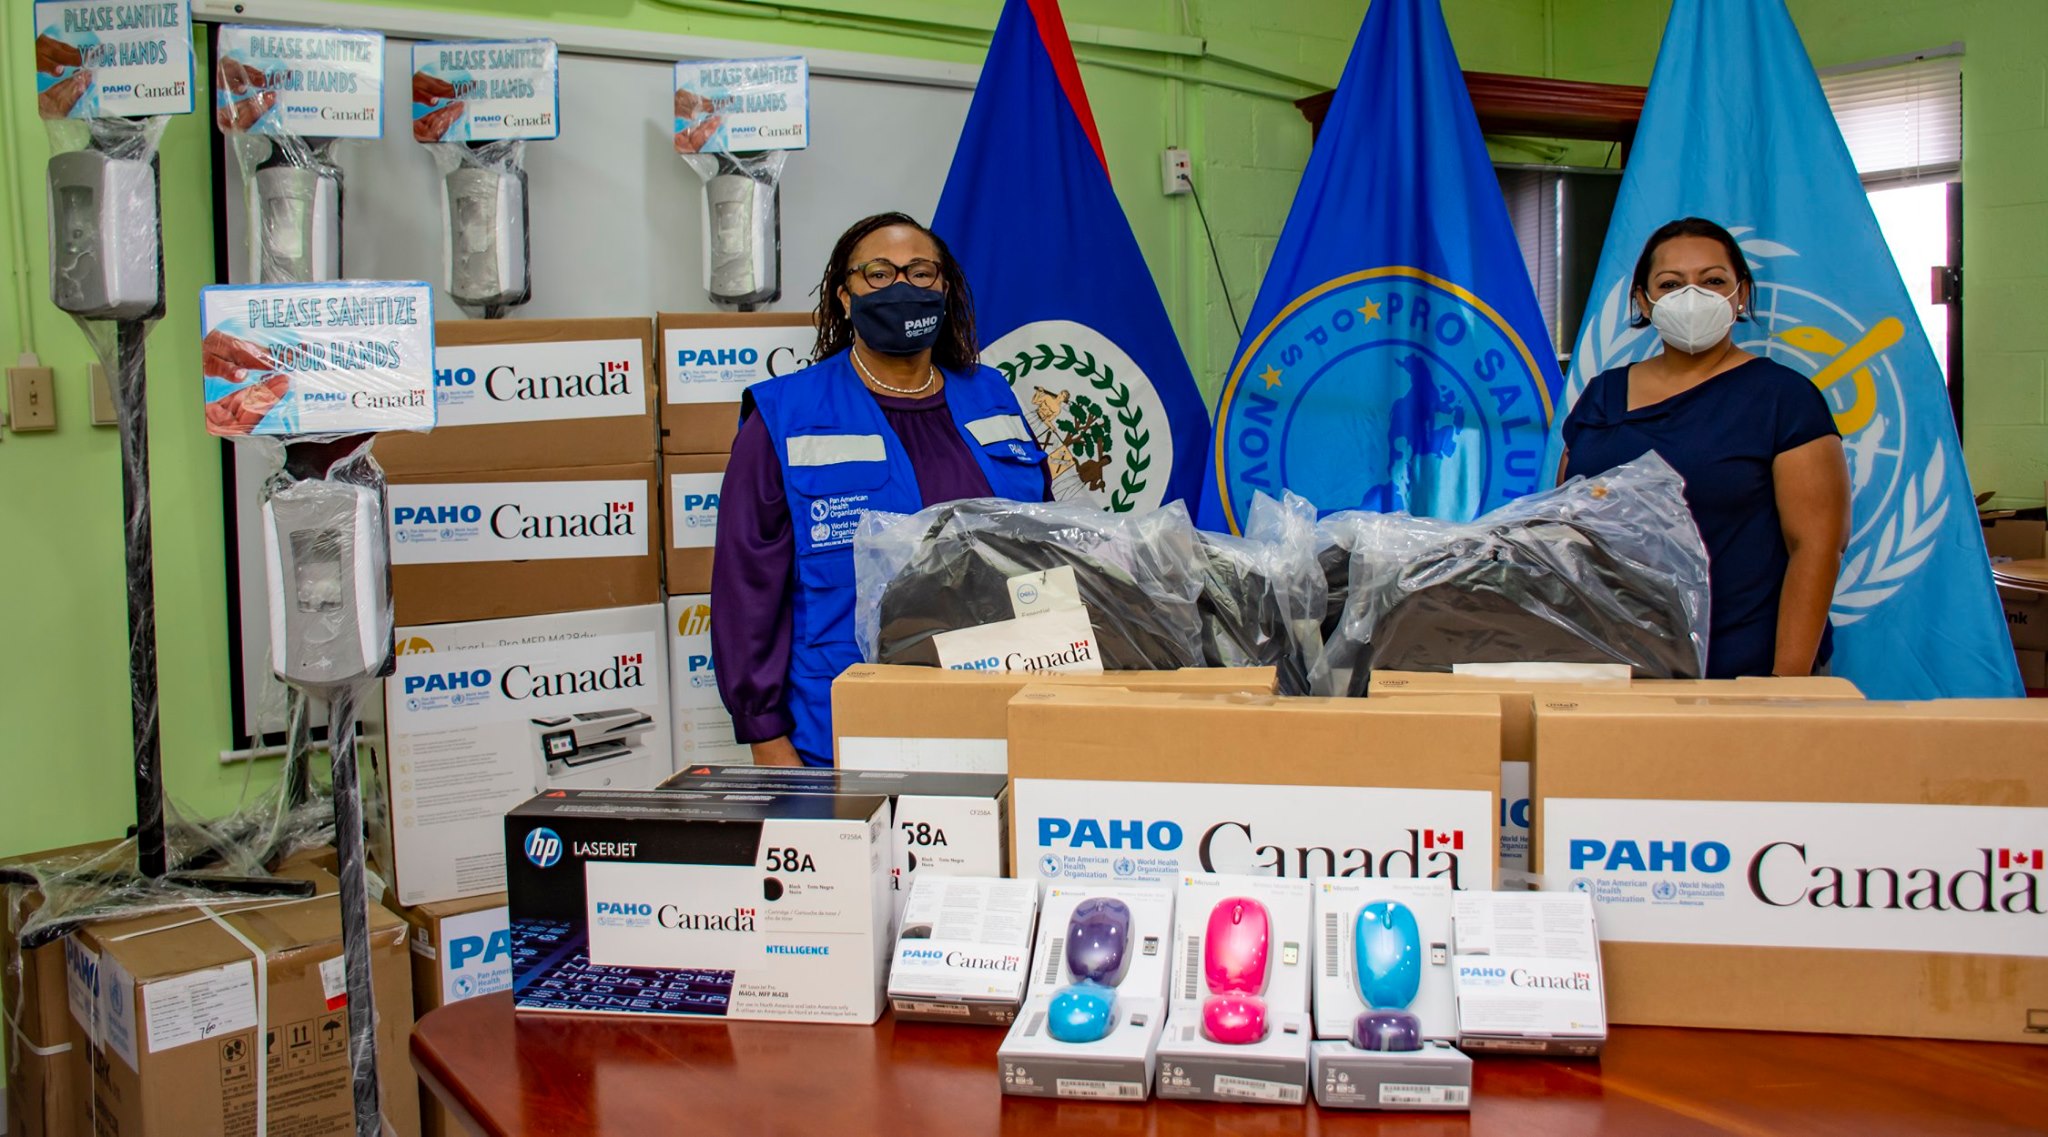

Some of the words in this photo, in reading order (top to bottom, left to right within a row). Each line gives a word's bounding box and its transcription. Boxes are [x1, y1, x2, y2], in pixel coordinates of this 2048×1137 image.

[64, 6, 114, 33] PLEASE
[116, 3, 178, 29] SANITIZE
[77, 43, 117, 67] YOUR
[120, 40, 167, 66] HANDS
[251, 36, 303, 60] PLEASE
[306, 38, 371, 63] SANITIZE
[440, 49, 485, 71] PLEASE
[264, 68, 304, 91] YOUR
[307, 70, 358, 94] HANDS
[700, 67, 742, 88] PLEASE
[744, 65, 798, 85] SANITIZE
[102, 84, 132, 94] PAHO
[134, 82, 185, 99] Canada
[451, 79, 488, 100] YOUR
[491, 79, 535, 99] HANDS
[320, 106, 375, 121] Canada
[712, 95, 744, 114] YOUR
[747, 92, 787, 112] HANDS
[474, 115, 501, 123] PAHO
[504, 113, 551, 127] Canada
[758, 124, 802, 137] Canada
[249, 298, 321, 328] PLEASE
[327, 296, 417, 327] SANITIZE
[904, 316, 937, 330] PAHO
[1387, 292, 1467, 346] PRO
[269, 343, 326, 372] YOUR
[331, 340, 400, 371] HANDS
[678, 348, 758, 366] PAHO
[435, 367, 476, 387] HO
[485, 361, 632, 401] Canada
[304, 392, 347, 401] PAHO
[351, 390, 426, 410] Canada
[1474, 348, 1537, 498] SALUT
[1239, 392, 1279, 507] NOV
[685, 494, 720, 511] PA
[394, 504, 482, 525] PAHO
[490, 502, 636, 540] Canada
[1005, 643, 1092, 671] Canada
[405, 669, 492, 694] PAHO
[500, 656, 645, 701] Canada
[902, 822, 948, 846] 58A
[530, 828, 559, 866] hp
[574, 841, 638, 858] LASERJET
[1038, 817, 1183, 851] PAHO
[1199, 821, 1468, 891] Canada
[766, 848, 816, 872] 58A
[1158, 859, 1179, 867] Health
[1064, 870, 1107, 879] Organization
[1569, 839, 1731, 872] PAHO
[1747, 842, 2048, 914] Canada
[1701, 882, 1724, 890] Health
[1597, 895, 1645, 903] Organization
[597, 901, 652, 916] PAHO
[658, 904, 756, 932] Canada
[450, 929, 511, 970] PA
[766, 945, 829, 955] NTELLIGENCE
[902, 950, 943, 959] PAHO
[946, 951, 1018, 972] Canada
[478, 982, 511, 995] Organizat
[1460, 968, 1506, 977] PAHO
[1511, 969, 1590, 991] Canada
